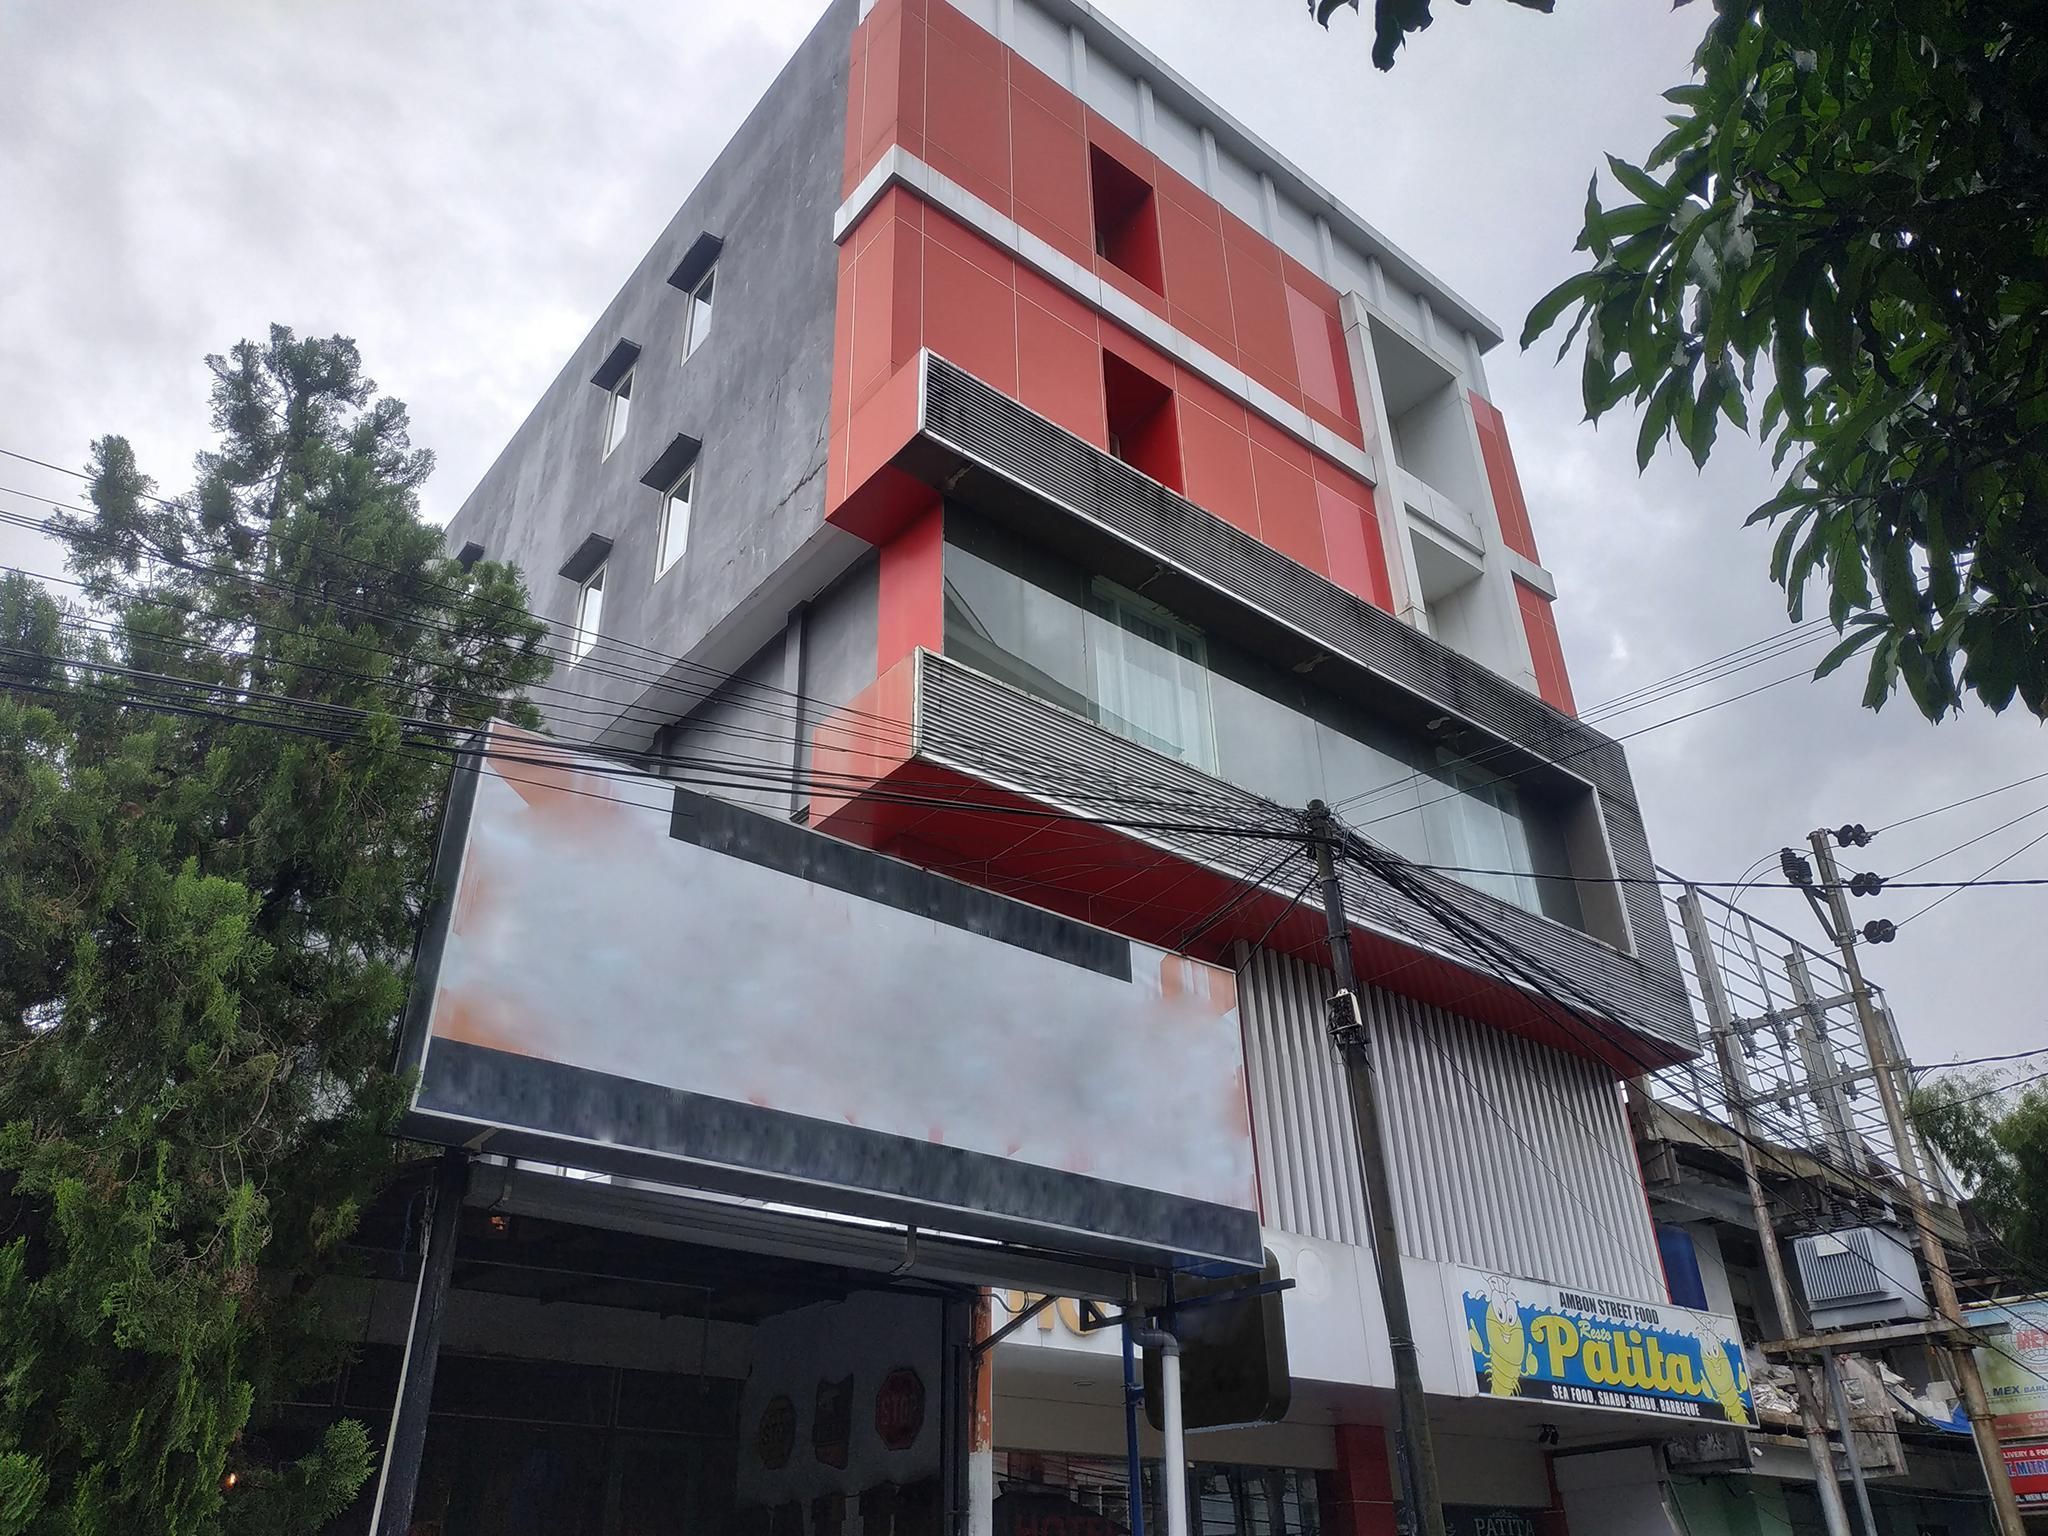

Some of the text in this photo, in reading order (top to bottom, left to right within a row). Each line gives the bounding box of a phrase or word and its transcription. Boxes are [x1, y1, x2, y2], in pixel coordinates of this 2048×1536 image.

[1559, 1291, 1659, 1325] AMBON STREET FOOD
[1530, 1314, 1703, 1396] Patita
[1551, 1384, 1569, 1400] SEA
[1571, 1387, 1598, 1405] FOOD,
[1660, 1400, 1701, 1417] BARBEQUE
[1992, 1385, 2020, 1397] MEX
[2029, 1449, 2036, 1457] &
